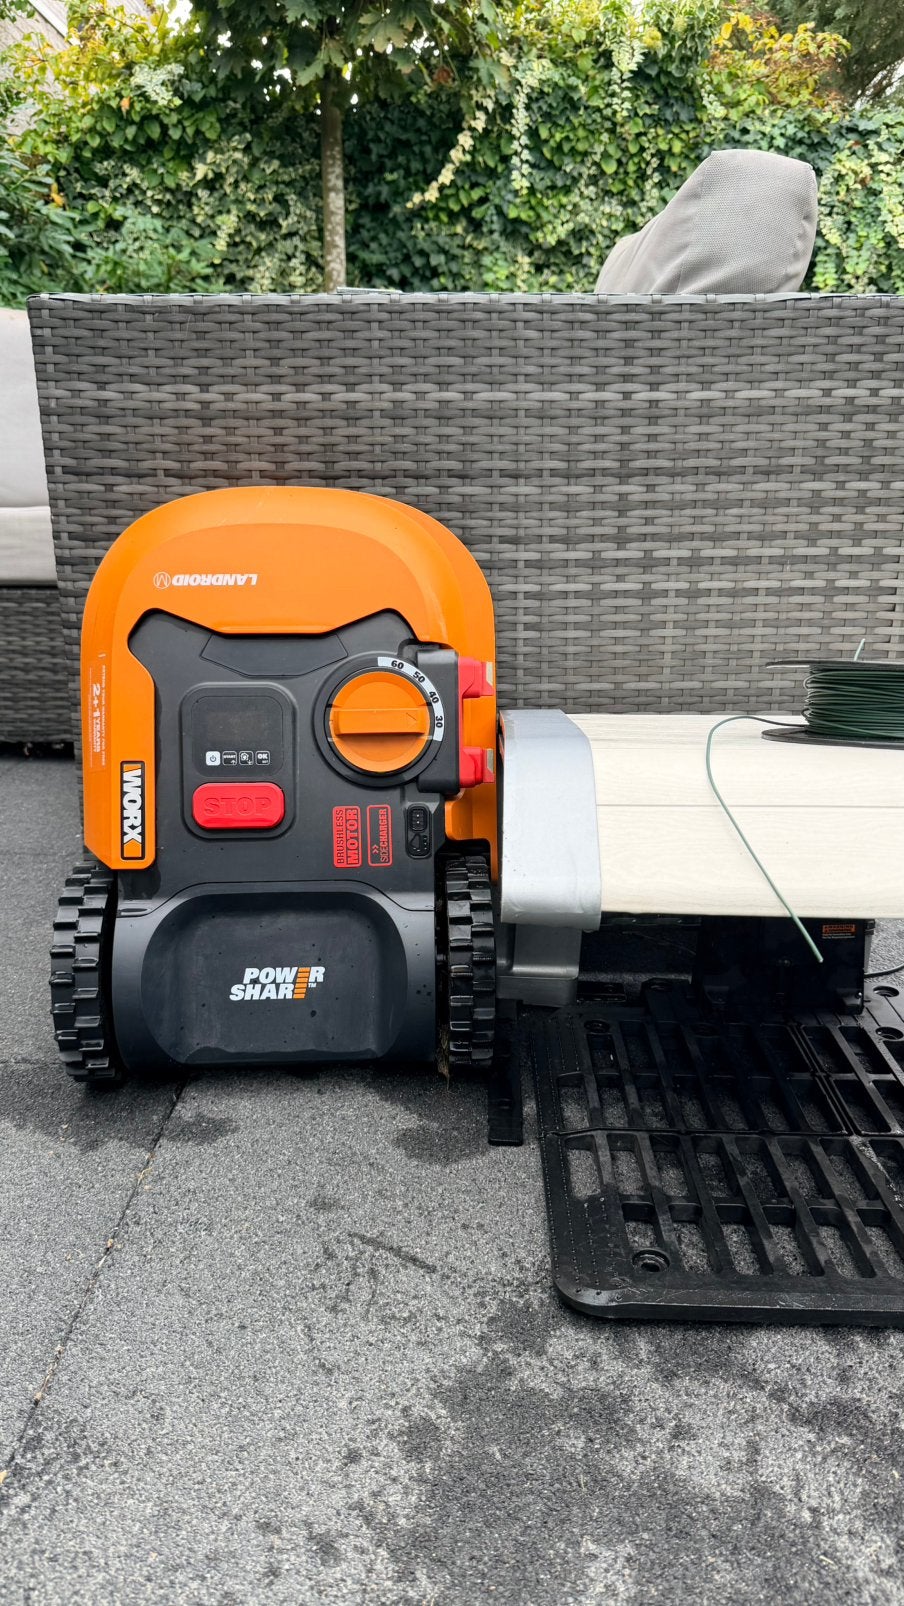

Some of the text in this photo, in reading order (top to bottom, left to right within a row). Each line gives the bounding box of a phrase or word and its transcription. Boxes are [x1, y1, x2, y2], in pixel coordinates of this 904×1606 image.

[172, 573, 258, 586] LANDROID
[391, 660, 404, 670] 60
[412, 671, 426, 683] 50
[93, 683, 101, 717] 2+1
[428, 691, 440, 704] 40
[435, 715, 443, 728] 30
[123, 768, 142, 844] WORX
[203, 796, 272, 816] STOP
[335, 809, 345, 864] BRUSHLESS
[346, 808, 359, 865] MOTOR
[379, 808, 389, 863] SIDECHARGER
[243, 966, 325, 984] POWER
[229, 984, 308, 1001] SHARE
